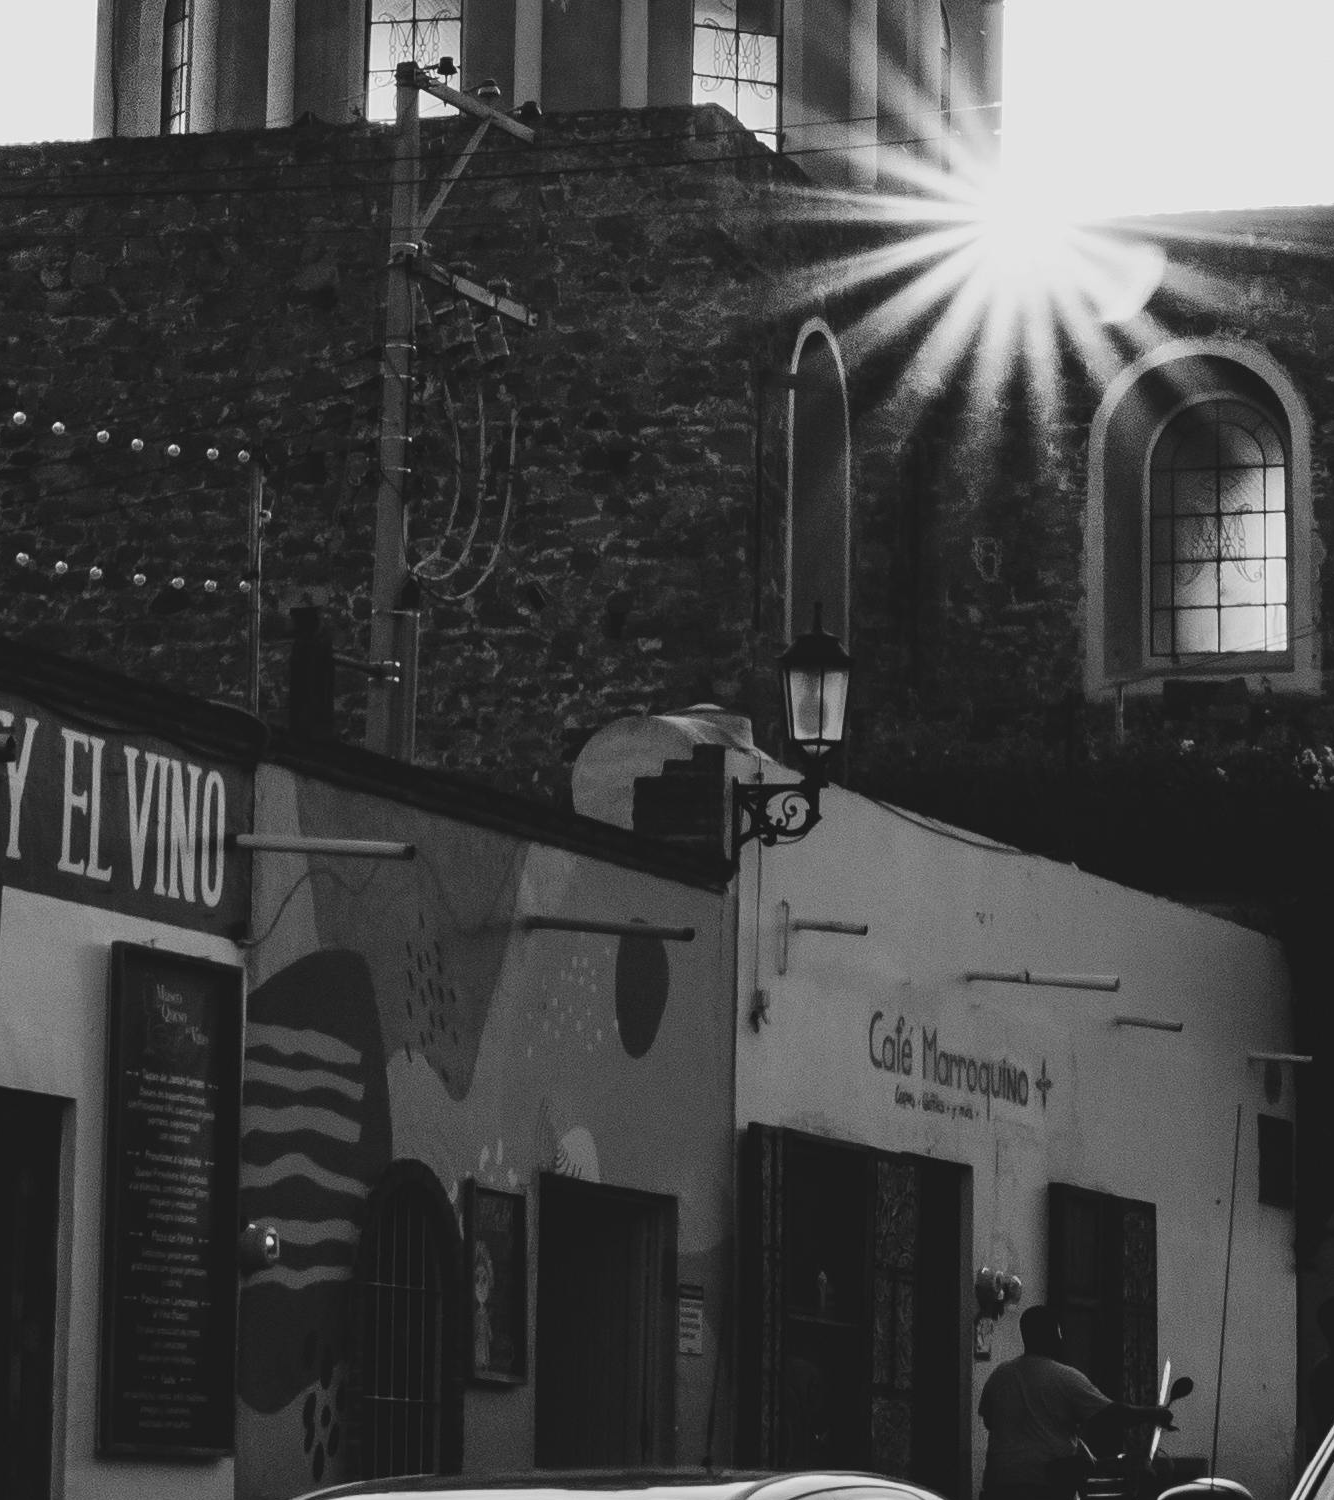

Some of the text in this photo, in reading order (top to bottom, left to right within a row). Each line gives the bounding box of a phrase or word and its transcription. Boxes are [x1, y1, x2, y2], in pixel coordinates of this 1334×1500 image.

[0, 709, 37, 861] Y
[57, 727, 113, 884] EL
[123, 743, 228, 910] VINO
[869, 1010, 914, 1076] Café
